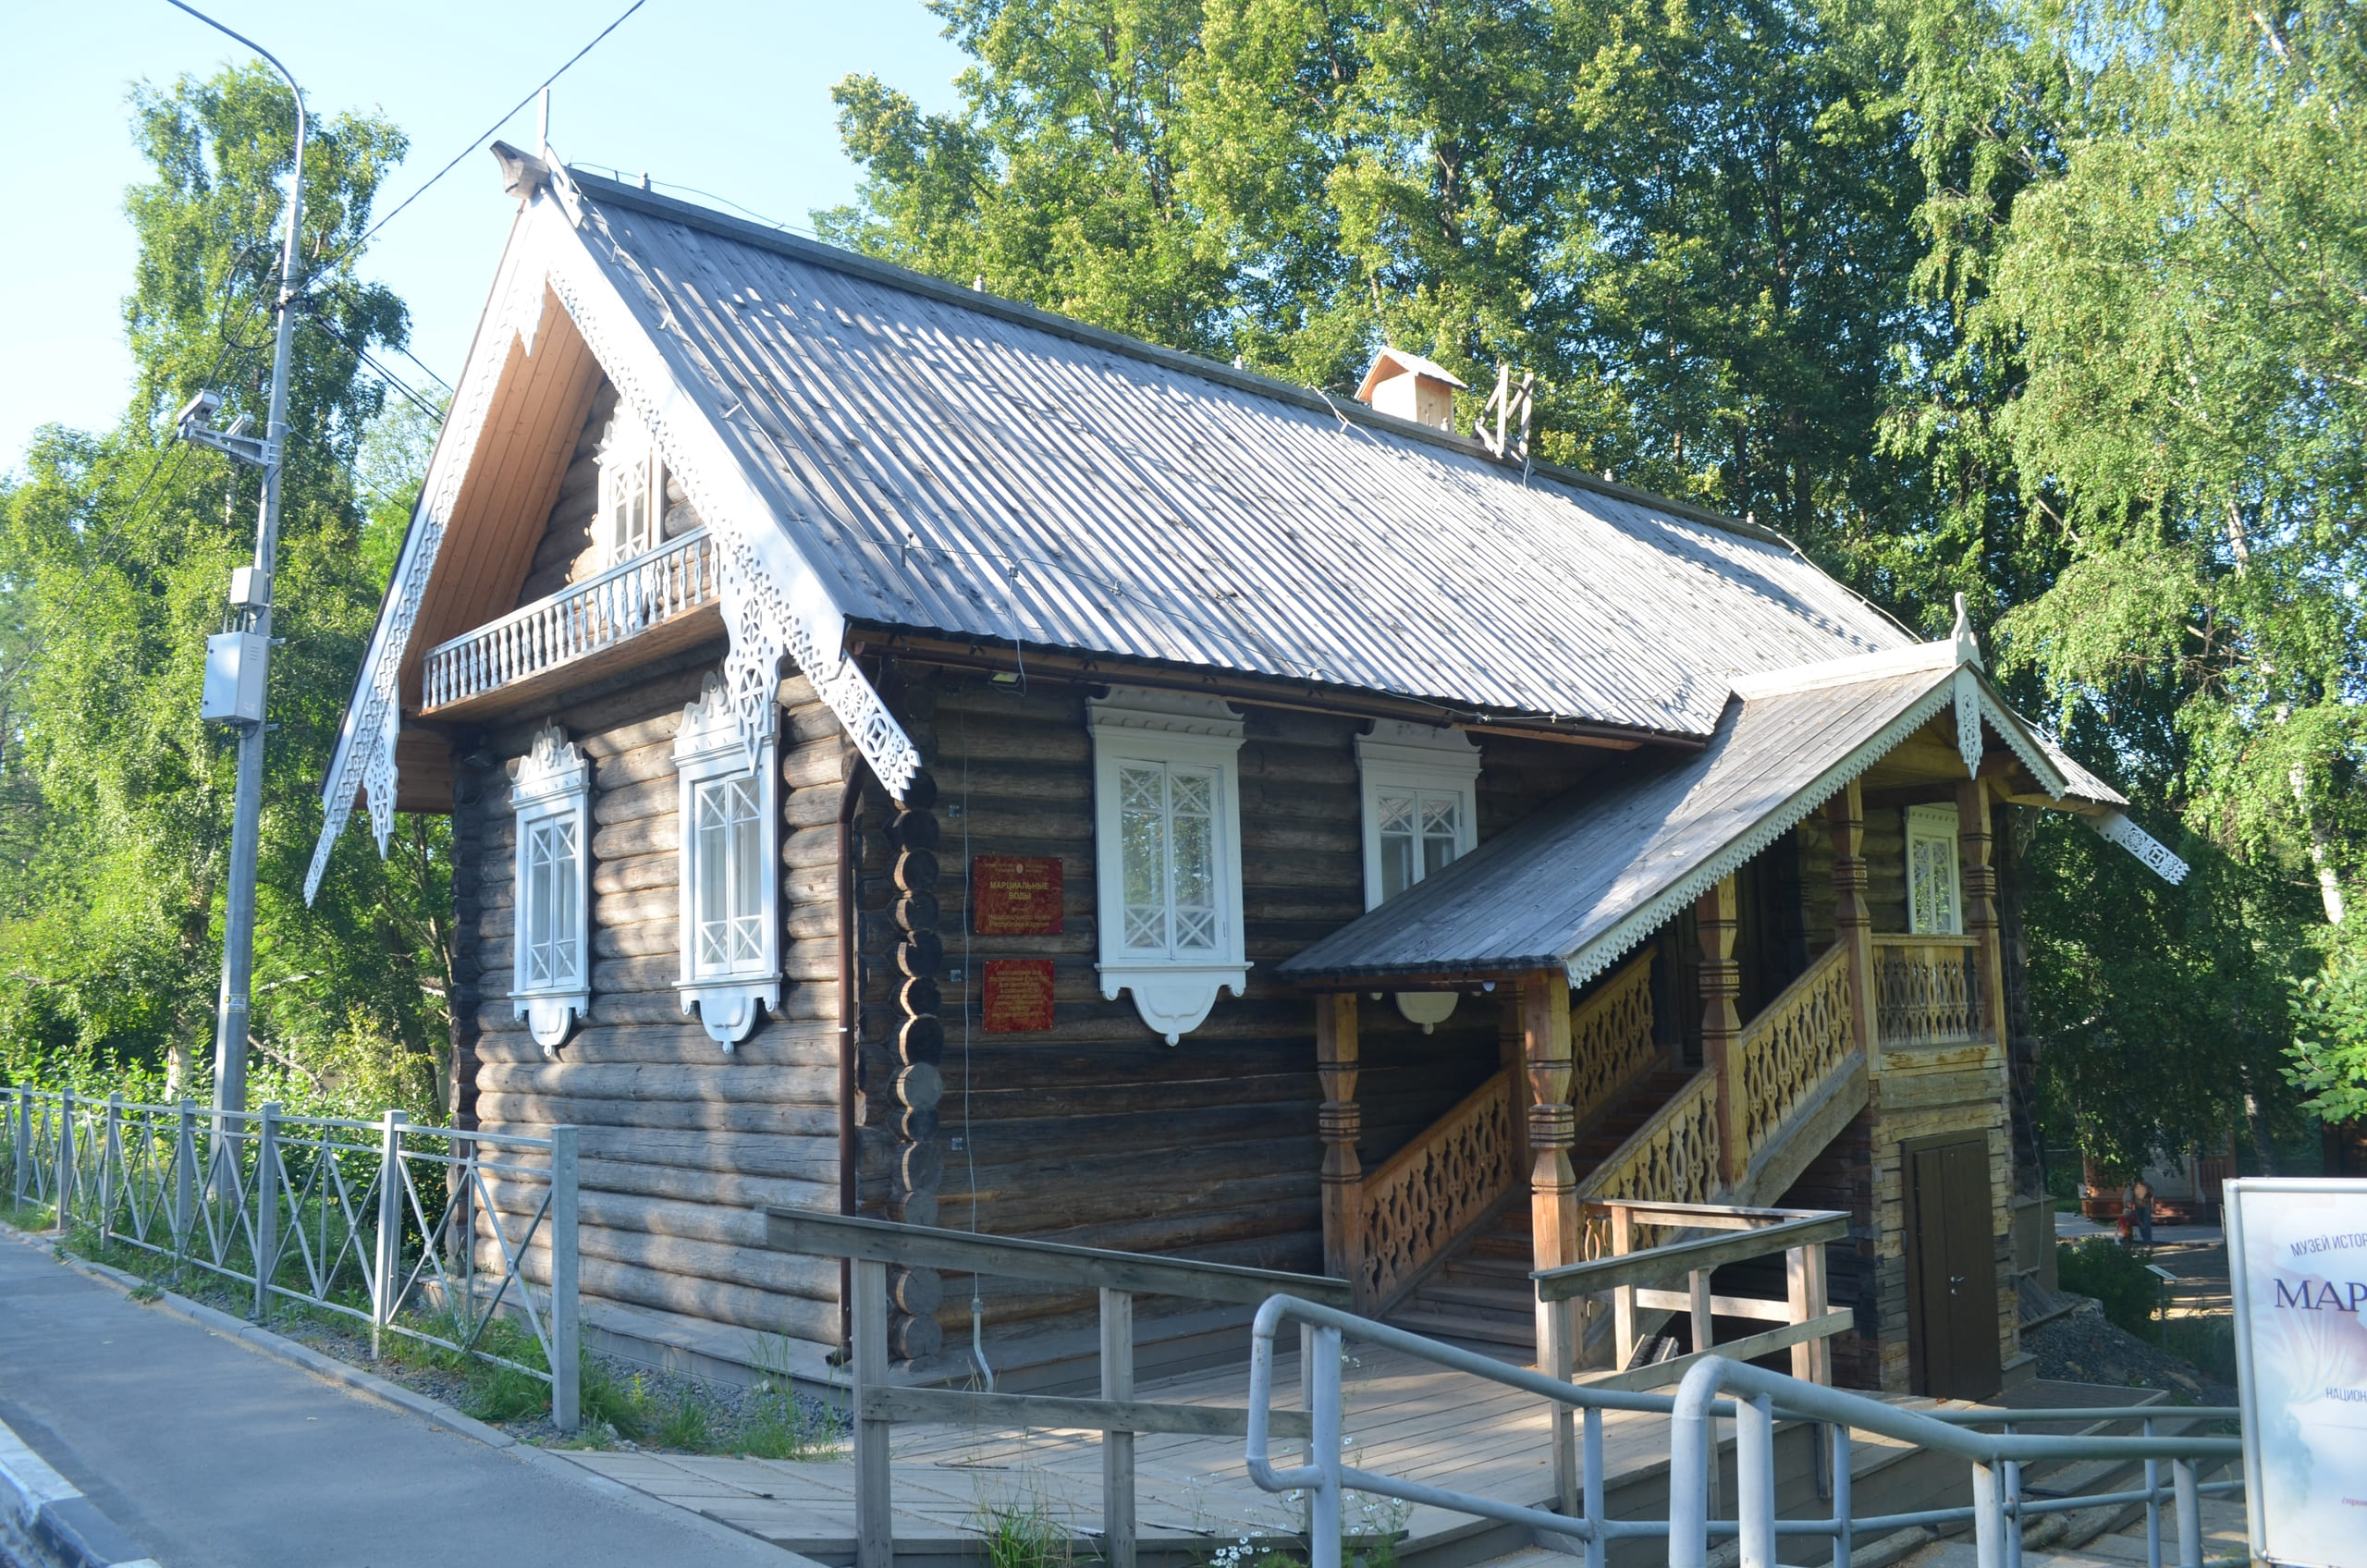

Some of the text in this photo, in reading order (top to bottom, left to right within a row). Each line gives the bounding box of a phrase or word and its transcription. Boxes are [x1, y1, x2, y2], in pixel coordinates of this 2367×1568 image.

[989, 881, 1049, 890] МАРЦИАЛЬНЫЕ
[1008, 891, 1031, 900] ВОДЫ
[2290, 1235, 2331, 1257] МУЗЕЙ
[2273, 1278, 2367, 1313] МАР
[2325, 1387, 2367, 1403] НАЦИОН
